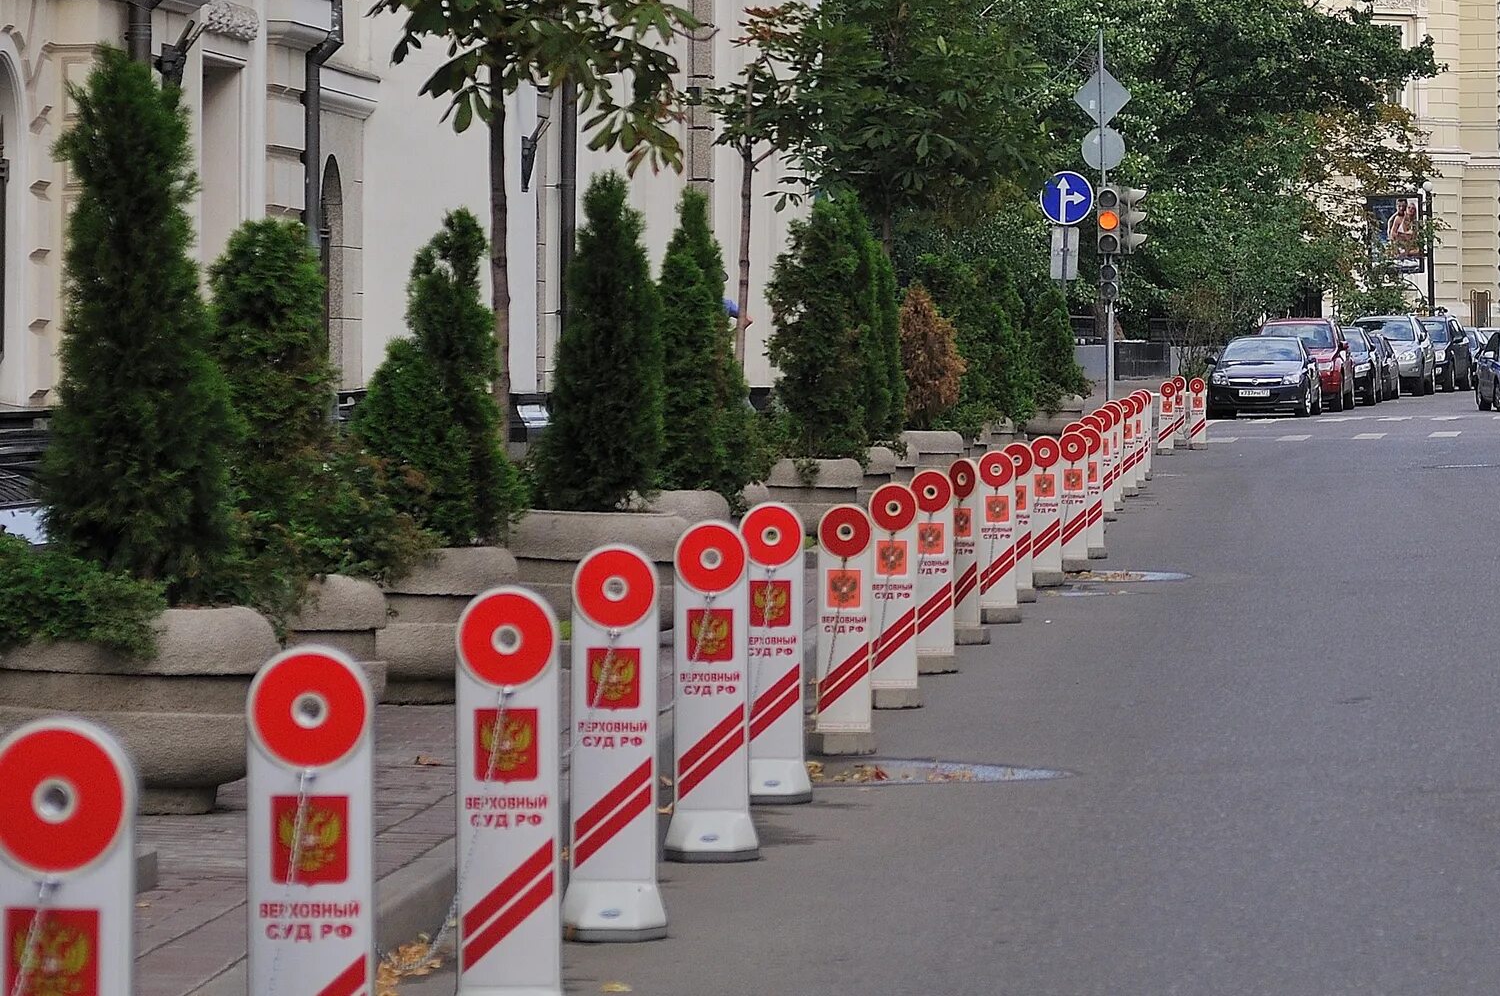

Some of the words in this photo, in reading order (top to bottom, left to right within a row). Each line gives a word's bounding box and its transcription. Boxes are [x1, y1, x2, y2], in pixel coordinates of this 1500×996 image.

[849, 625, 863, 633] РФ
[775, 647, 793, 656] РФ
[680, 672, 740, 683] ВЕРХОВНЫЙ
[684, 686, 711, 697] СУД
[716, 686, 736, 695] РФ
[578, 721, 648, 733] ВЕРХОВНЫЙ
[582, 736, 614, 748] СУД
[620, 736, 643, 747] РФ
[470, 813, 508, 828] СУД
[515, 813, 543, 827] РФ
[265, 923, 313, 942] СУД
[320, 923, 353, 940] РФ
